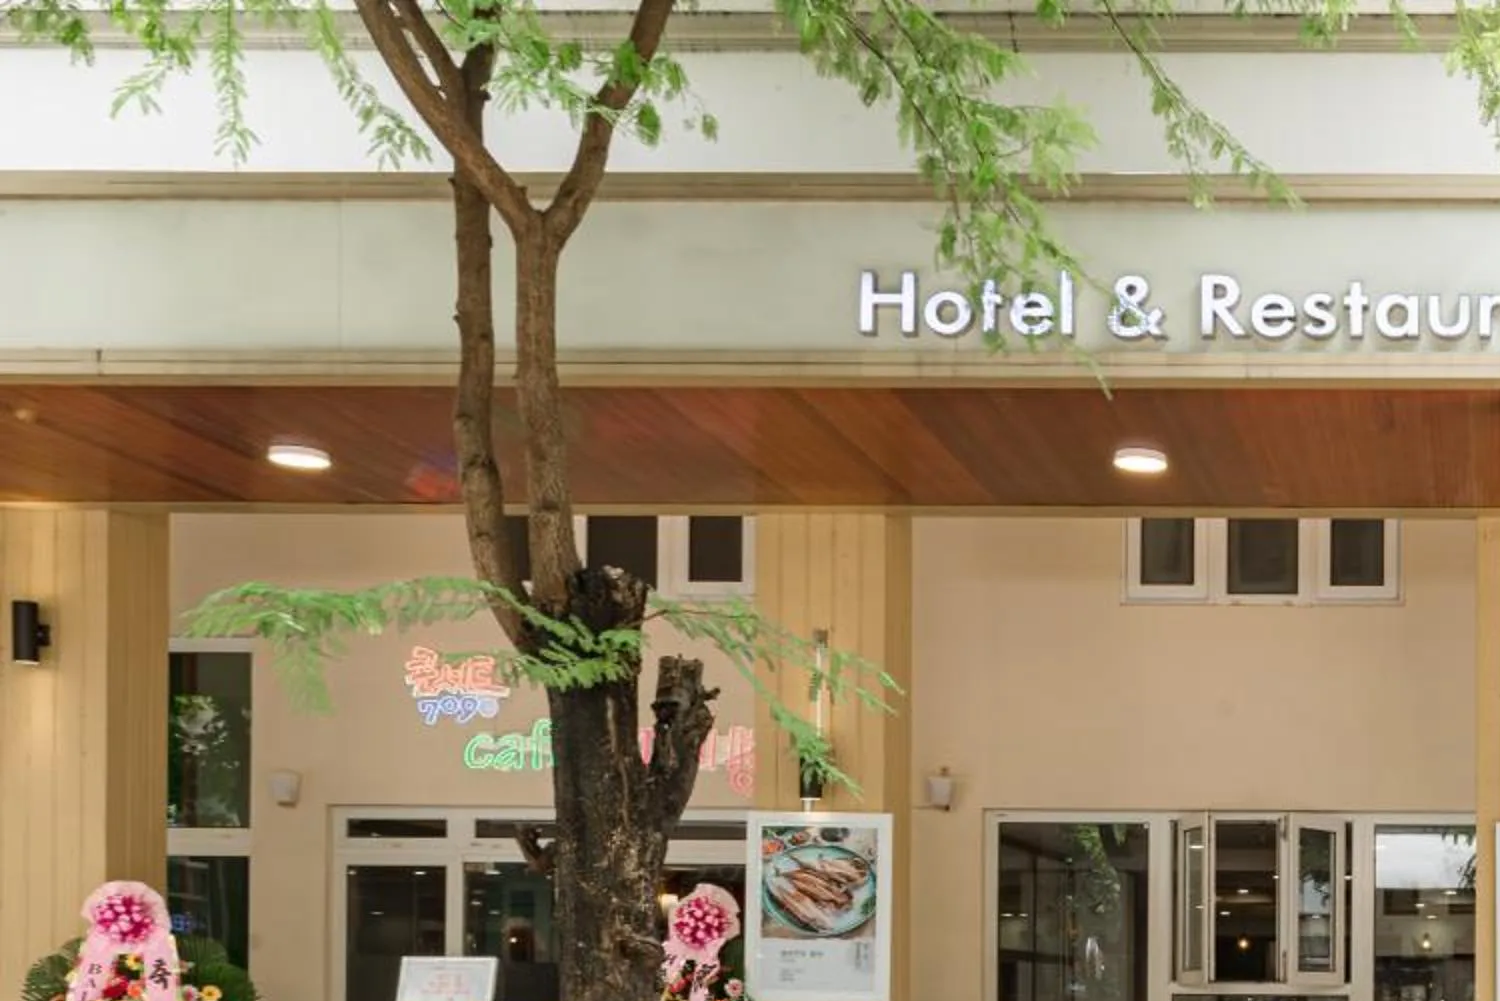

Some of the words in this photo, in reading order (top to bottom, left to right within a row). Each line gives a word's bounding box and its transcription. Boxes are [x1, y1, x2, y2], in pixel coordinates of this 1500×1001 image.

[859, 271, 1075, 337] Hotel
[1107, 274, 1167, 339] &
[463, 718, 558, 771] caf
